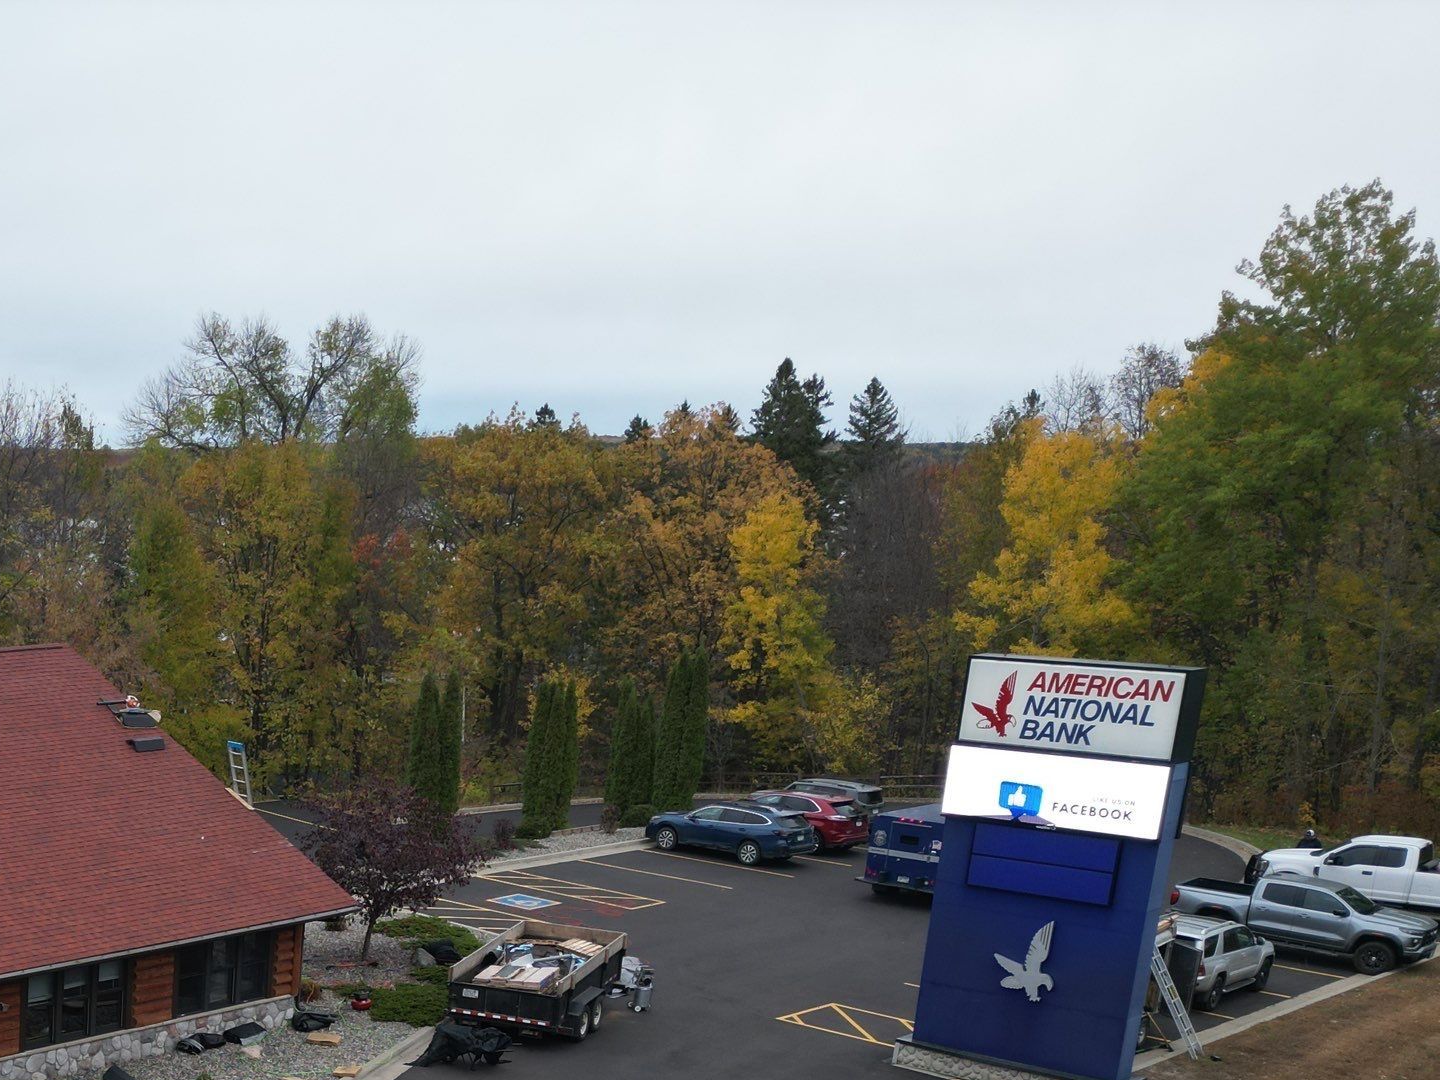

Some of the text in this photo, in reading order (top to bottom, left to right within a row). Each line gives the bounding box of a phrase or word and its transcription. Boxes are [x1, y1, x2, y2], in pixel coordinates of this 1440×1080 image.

[1027, 672, 1175, 702] AMERICAN
[1023, 695, 1155, 727] NATIONAL
[1019, 719, 1096, 746] BANK
[1052, 802, 1132, 821] FACEBOOK
